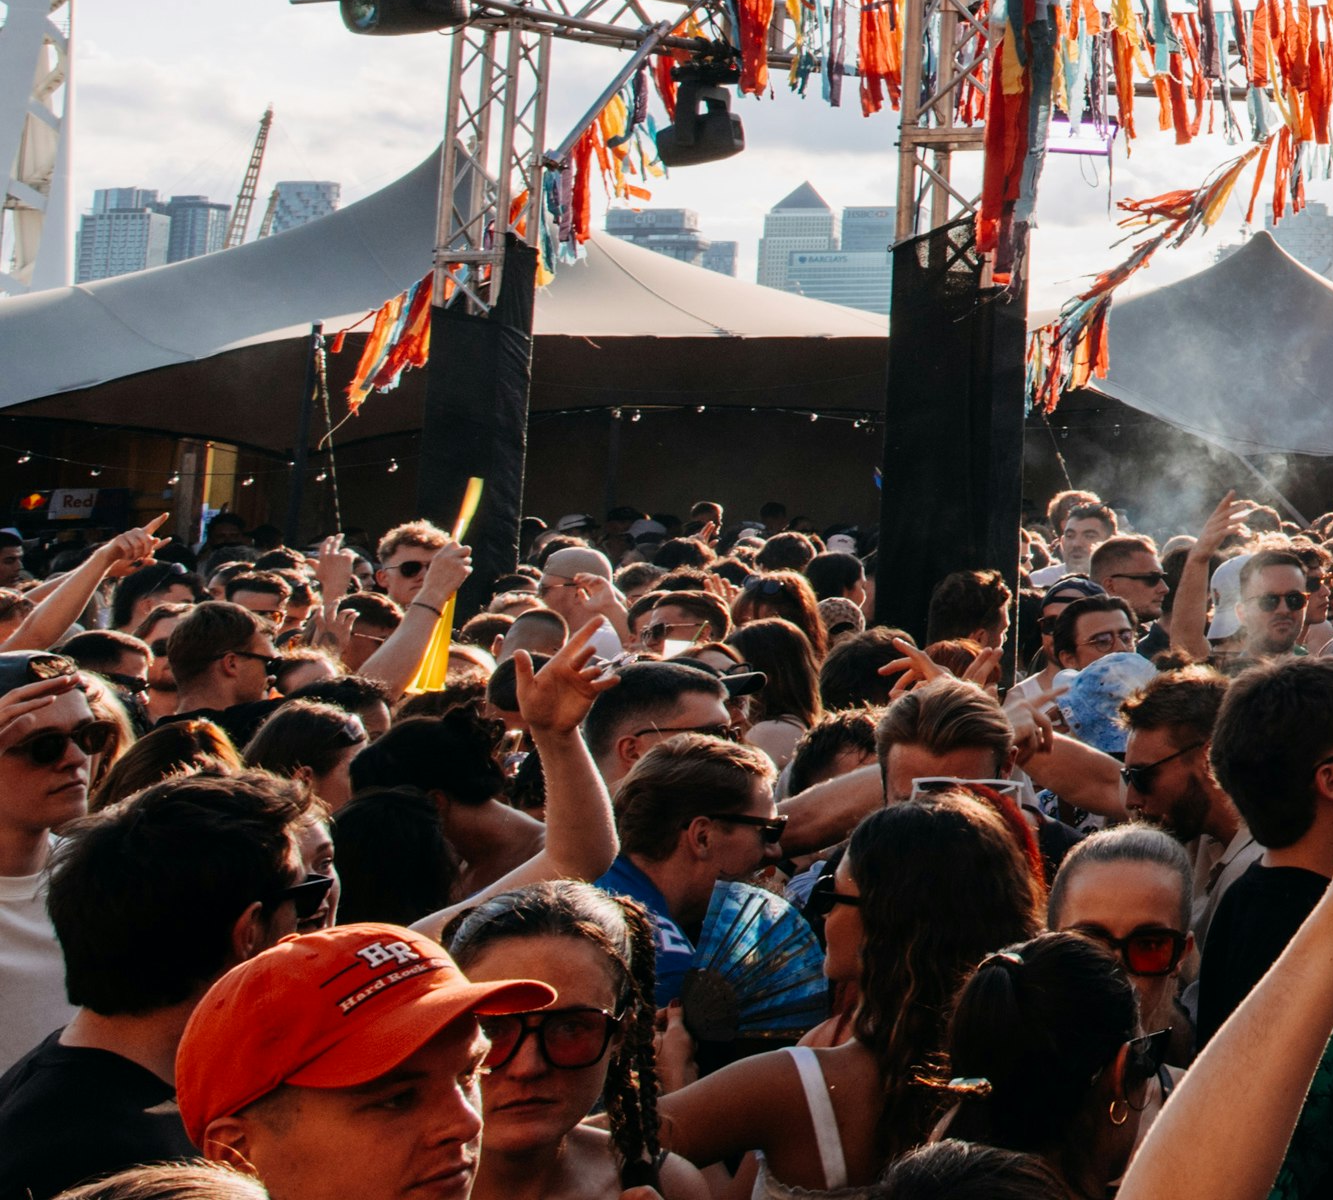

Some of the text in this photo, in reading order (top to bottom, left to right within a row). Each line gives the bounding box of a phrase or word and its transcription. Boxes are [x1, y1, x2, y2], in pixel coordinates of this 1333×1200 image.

[63, 495, 95, 508] Red
[356, 941, 419, 968] HR
[339, 964, 428, 1011] Hard Rock
